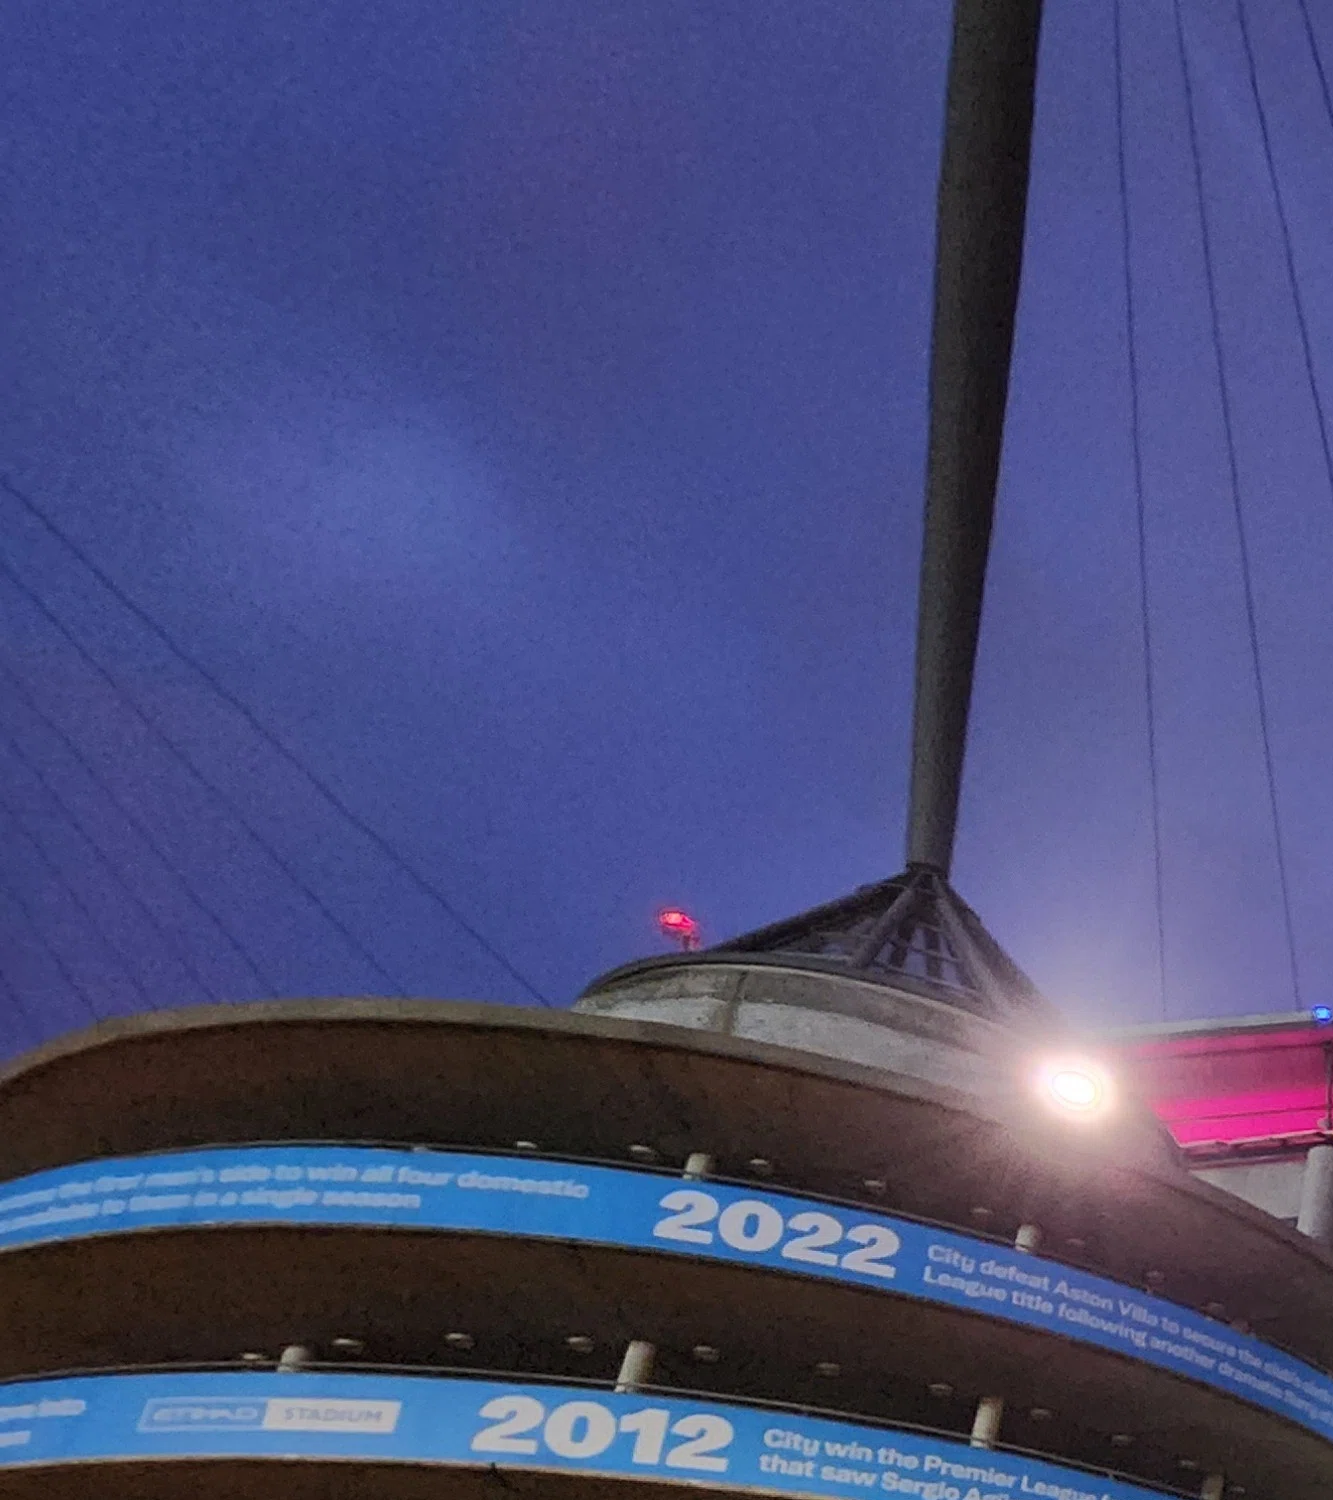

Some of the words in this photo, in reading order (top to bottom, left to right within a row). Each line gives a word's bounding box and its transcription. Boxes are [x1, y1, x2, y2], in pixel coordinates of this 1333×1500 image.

[653, 1190, 900, 1278] 2022
[923, 1266, 1007, 1301] League
[1011, 1290, 1054, 1314] title
[1057, 1302, 1148, 1348] following
[928, 1244, 976, 1274] City
[980, 1259, 1049, 1291] defeat
[1053, 1280, 1113, 1311] Aston
[1118, 1299, 1158, 1326] Villa
[1161, 1316, 1180, 1335] to
[283, 1406, 383, 1423] STADIUM
[470, 1397, 734, 1473] 2012
[760, 1454, 816, 1477] that
[821, 1465, 878, 1486] saw
[764, 1429, 819, 1456] City
[824, 1440, 872, 1463] win
[878, 1447, 919, 1469] the
[923, 1456, 1018, 1488] Premier
